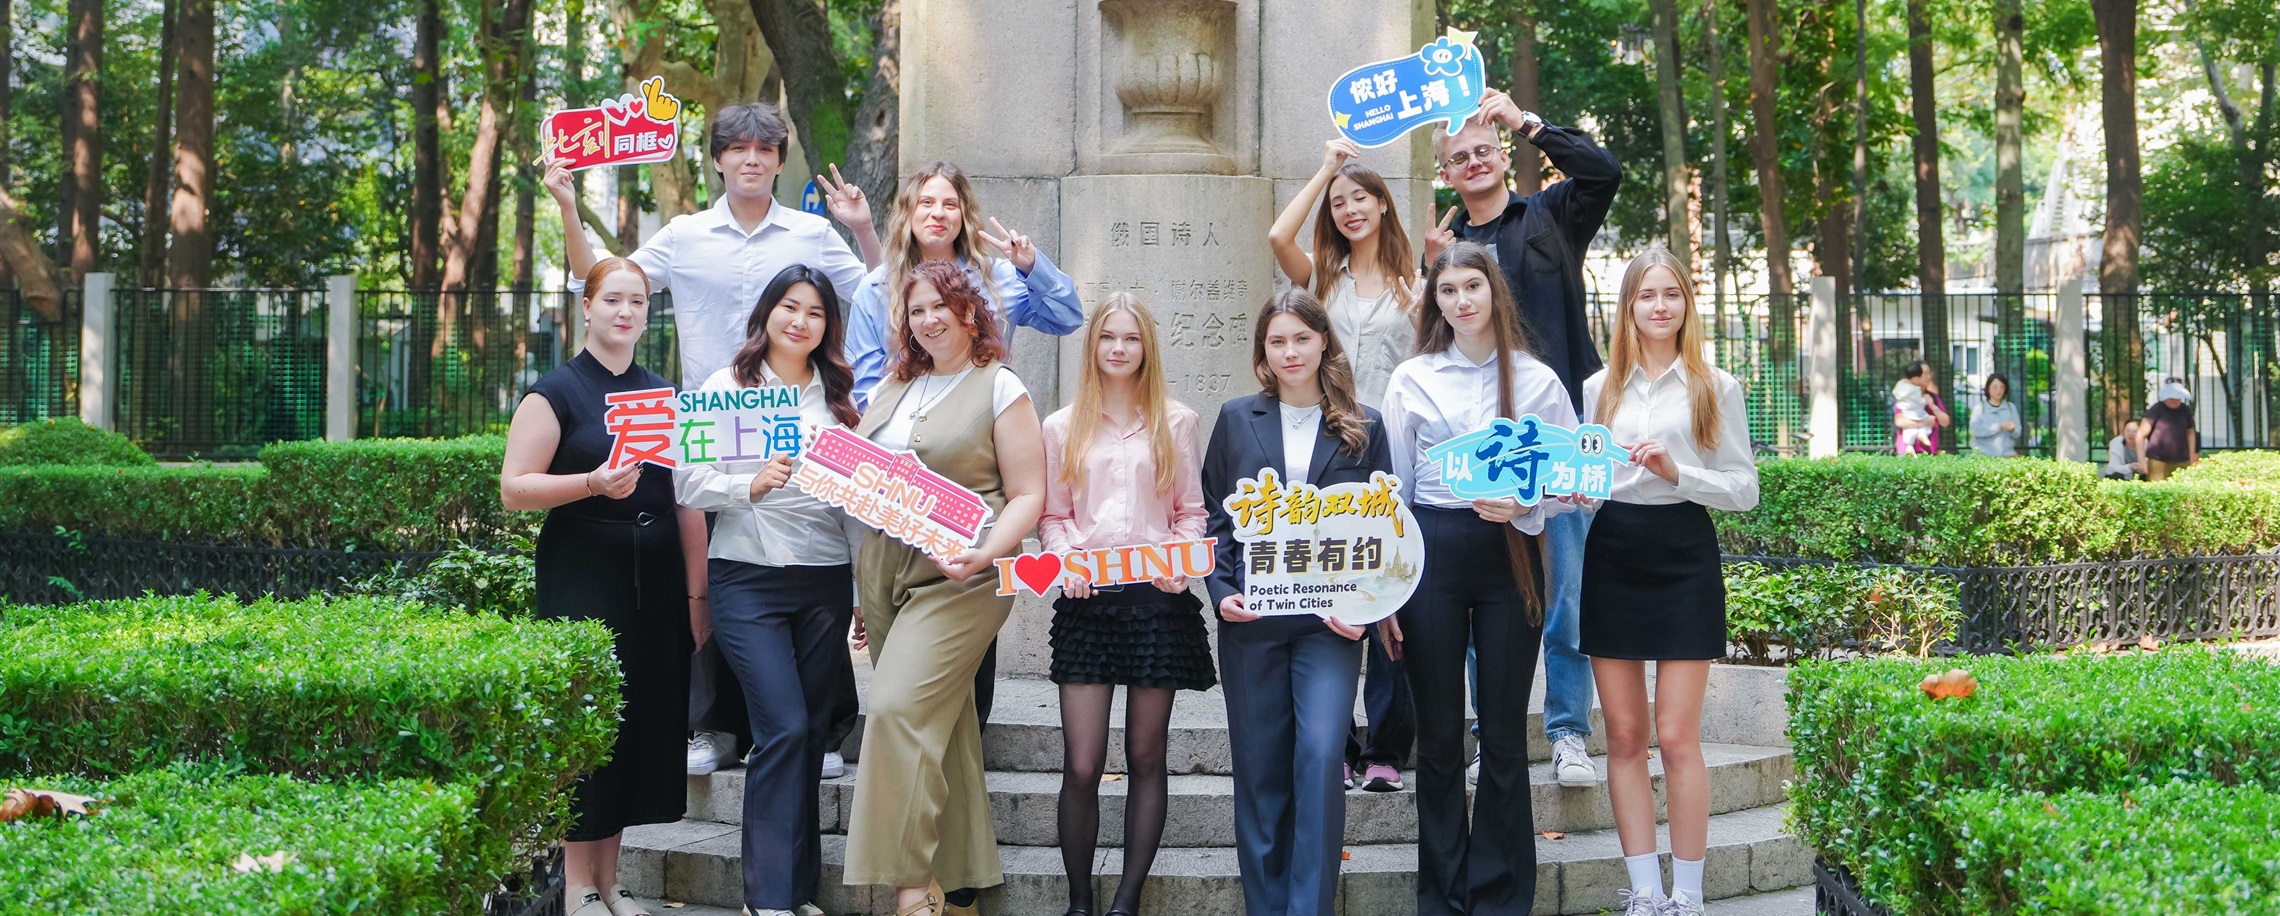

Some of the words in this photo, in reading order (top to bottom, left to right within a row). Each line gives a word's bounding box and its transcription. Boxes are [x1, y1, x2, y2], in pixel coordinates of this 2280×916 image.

[1350, 69, 1398, 105] 侬好
[1353, 112, 1395, 131] SHANGHAI
[1365, 104, 1392, 118] HELLO
[1111, 221, 1221, 247] 俄国诗人
[680, 387, 799, 413] SHANGHAI
[853, 463, 935, 517] SHNU
[1229, 472, 1405, 538] 诗韵双城
[793, 464, 967, 561] 与你共赴美好未来
[995, 559, 1017, 595] I
[1063, 539, 1217, 588] SHNU
[1249, 537, 1384, 575] 青春有约
[1250, 583, 1289, 596] Poetic
[1293, 582, 1357, 595] Resonance
[1250, 600, 1262, 611] of
[1267, 599, 1296, 610] Twin
[1300, 597, 1333, 609] Cities
